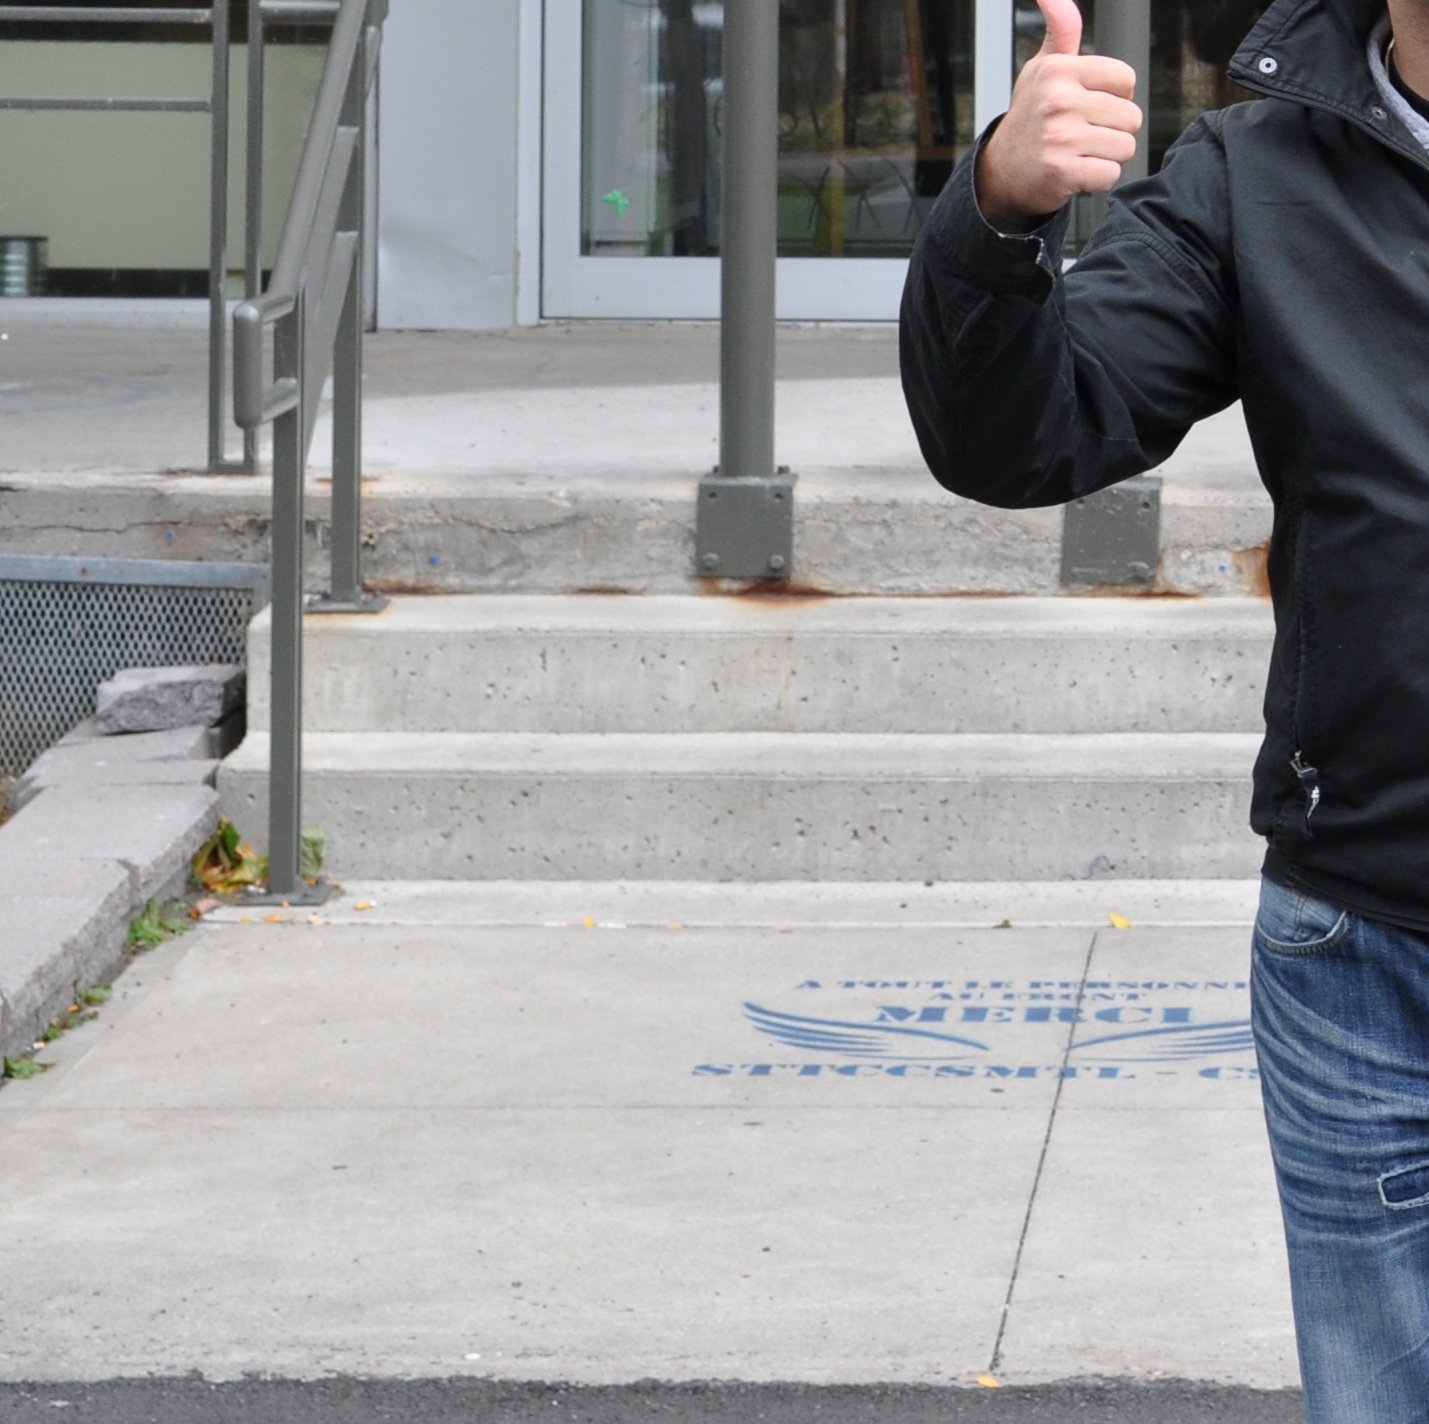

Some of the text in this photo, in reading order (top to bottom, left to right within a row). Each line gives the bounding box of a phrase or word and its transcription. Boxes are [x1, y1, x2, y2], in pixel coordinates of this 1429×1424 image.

[838, 980, 952, 991] TOUT
[962, 980, 1015, 991] LE
[1027, 980, 1251, 991] PERSONN
[870, 1006, 1194, 1024] MERCI
